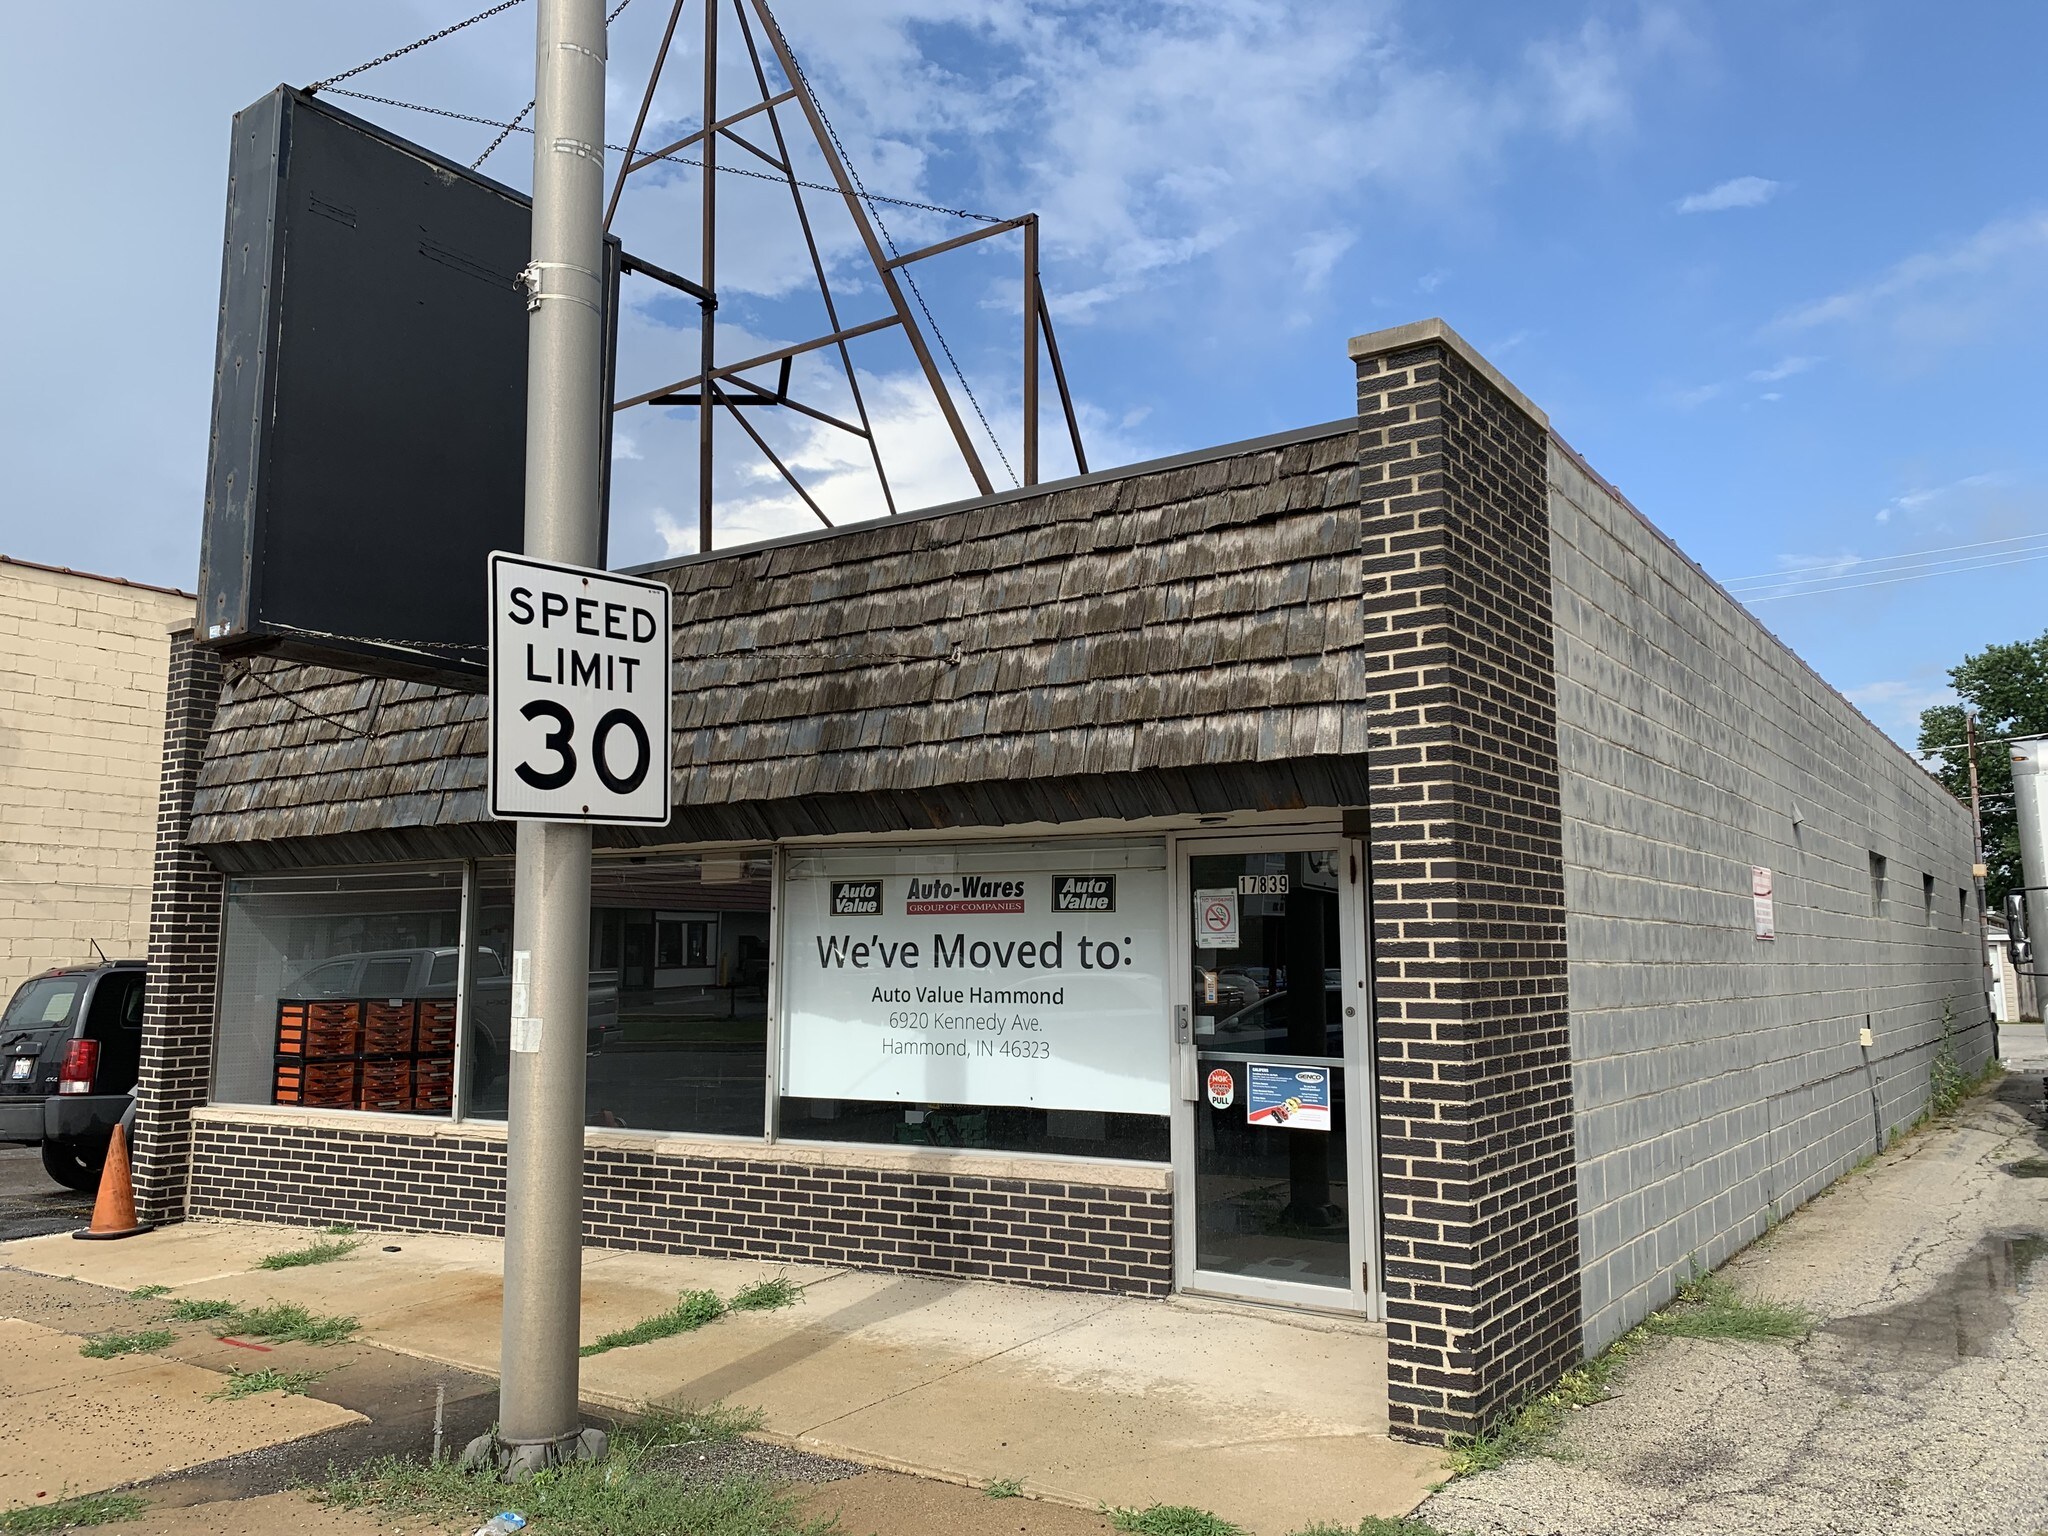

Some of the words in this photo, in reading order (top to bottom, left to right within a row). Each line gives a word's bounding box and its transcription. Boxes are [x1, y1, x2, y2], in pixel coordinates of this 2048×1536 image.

[508, 586, 656, 643] SPEED
[527, 643, 640, 693] LIMIT
[514, 699, 650, 794] 30
[838, 883, 876, 898] Auto
[907, 876, 1025, 899] Auto-Wares
[1061, 878, 1107, 893] Auto
[1240, 876, 1288, 894] 17839
[836, 898, 877, 913] Value
[909, 904, 944, 912] GROUP
[961, 902, 1022, 911] COMPANIES
[1059, 894, 1109, 909] Value
[816, 934, 919, 969] We've
[934, 931, 1062, 969] Moved
[1078, 934, 1132, 970] to:
[871, 986, 911, 1003] Auto
[916, 986, 964, 1004] Value
[970, 987, 1064, 1005] Hammond
[889, 1011, 929, 1030] 6920
[935, 1012, 1006, 1035] Kennedy
[1011, 1015, 1043, 1032] Ave.
[882, 1038, 971, 1059] Hammond,
[976, 1040, 994, 1057] IN
[999, 1041, 1050, 1060] 46323
[1297, 1073, 1322, 1081] GENCO
[1212, 1096, 1230, 1105] PULL
